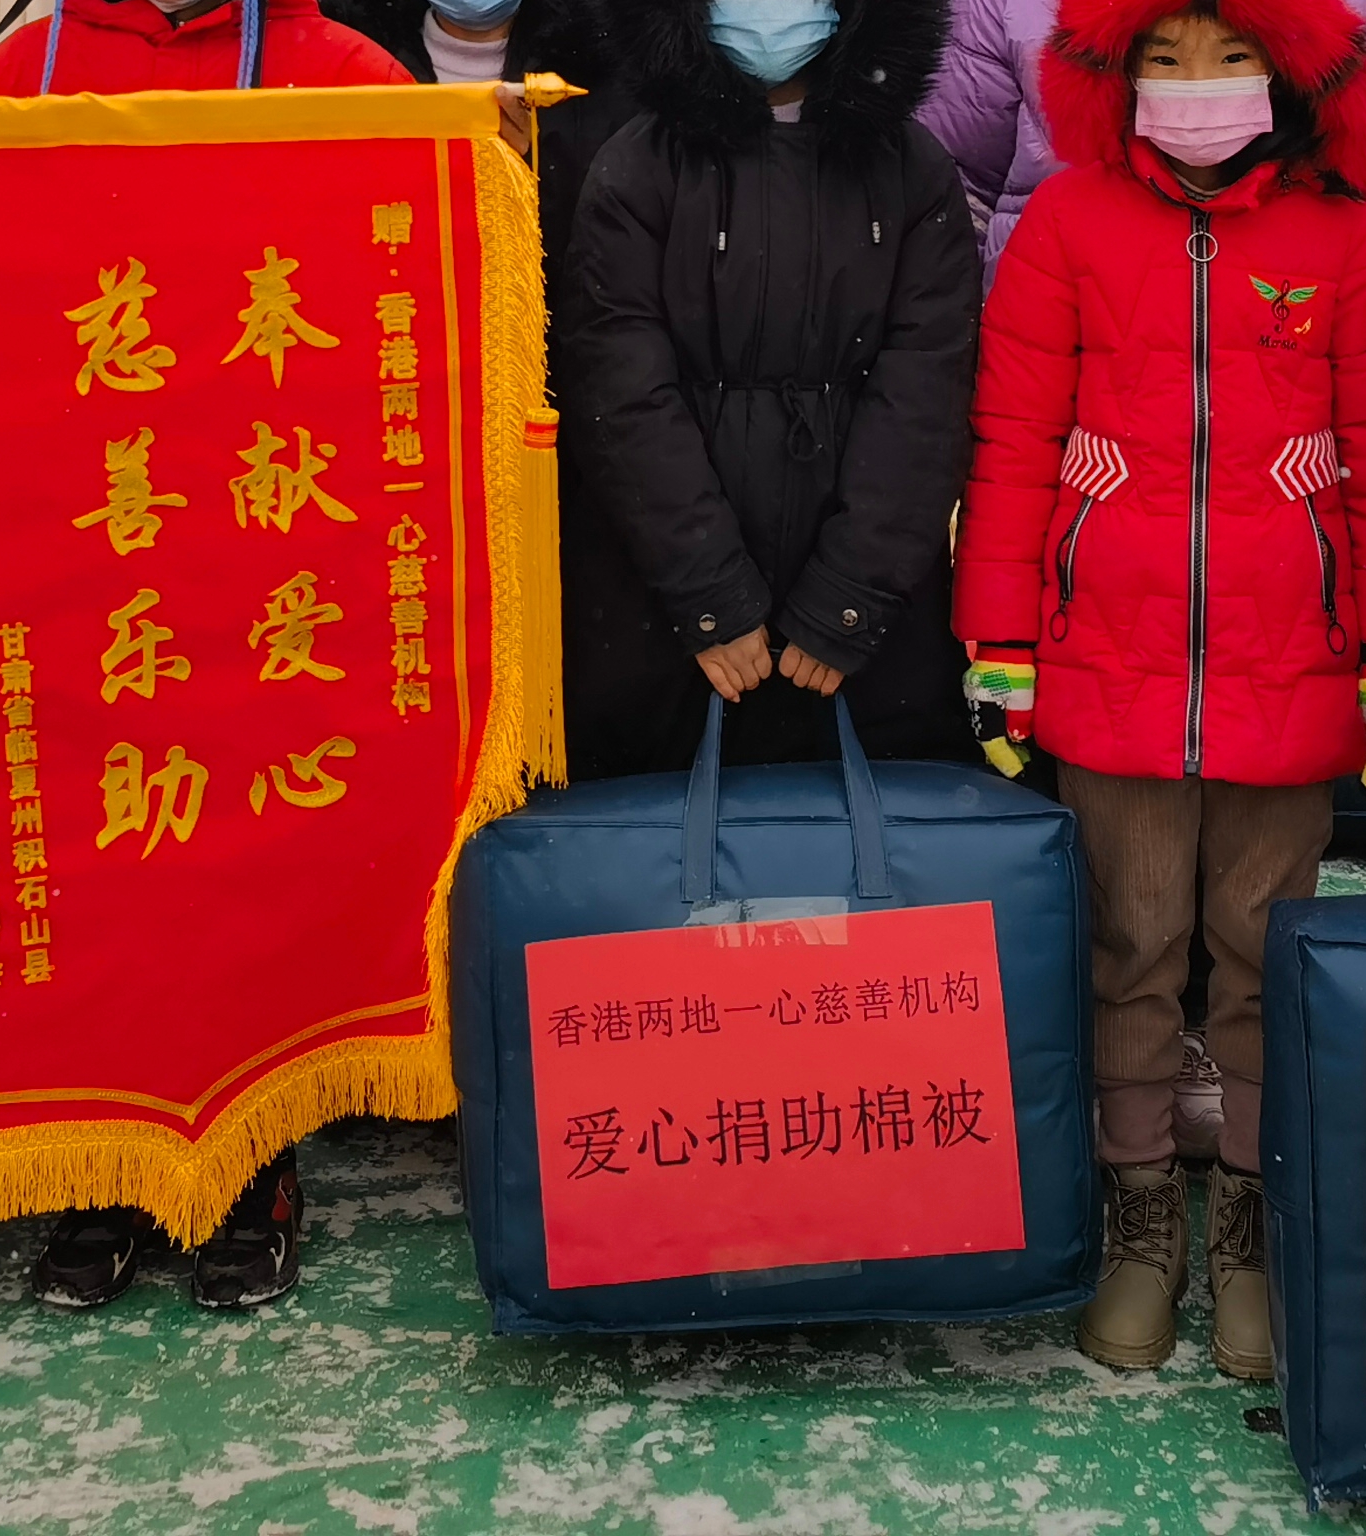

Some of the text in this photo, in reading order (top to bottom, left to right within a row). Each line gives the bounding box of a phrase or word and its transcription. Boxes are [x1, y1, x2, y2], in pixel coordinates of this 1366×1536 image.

[63, 255, 209, 861] 慈善乐助
[220, 245, 358, 816] 奉献爱心
[546, 970, 982, 1048] 香港两地一心慈善机构
[563, 1077, 993, 1181] 爱心捐助棉被
